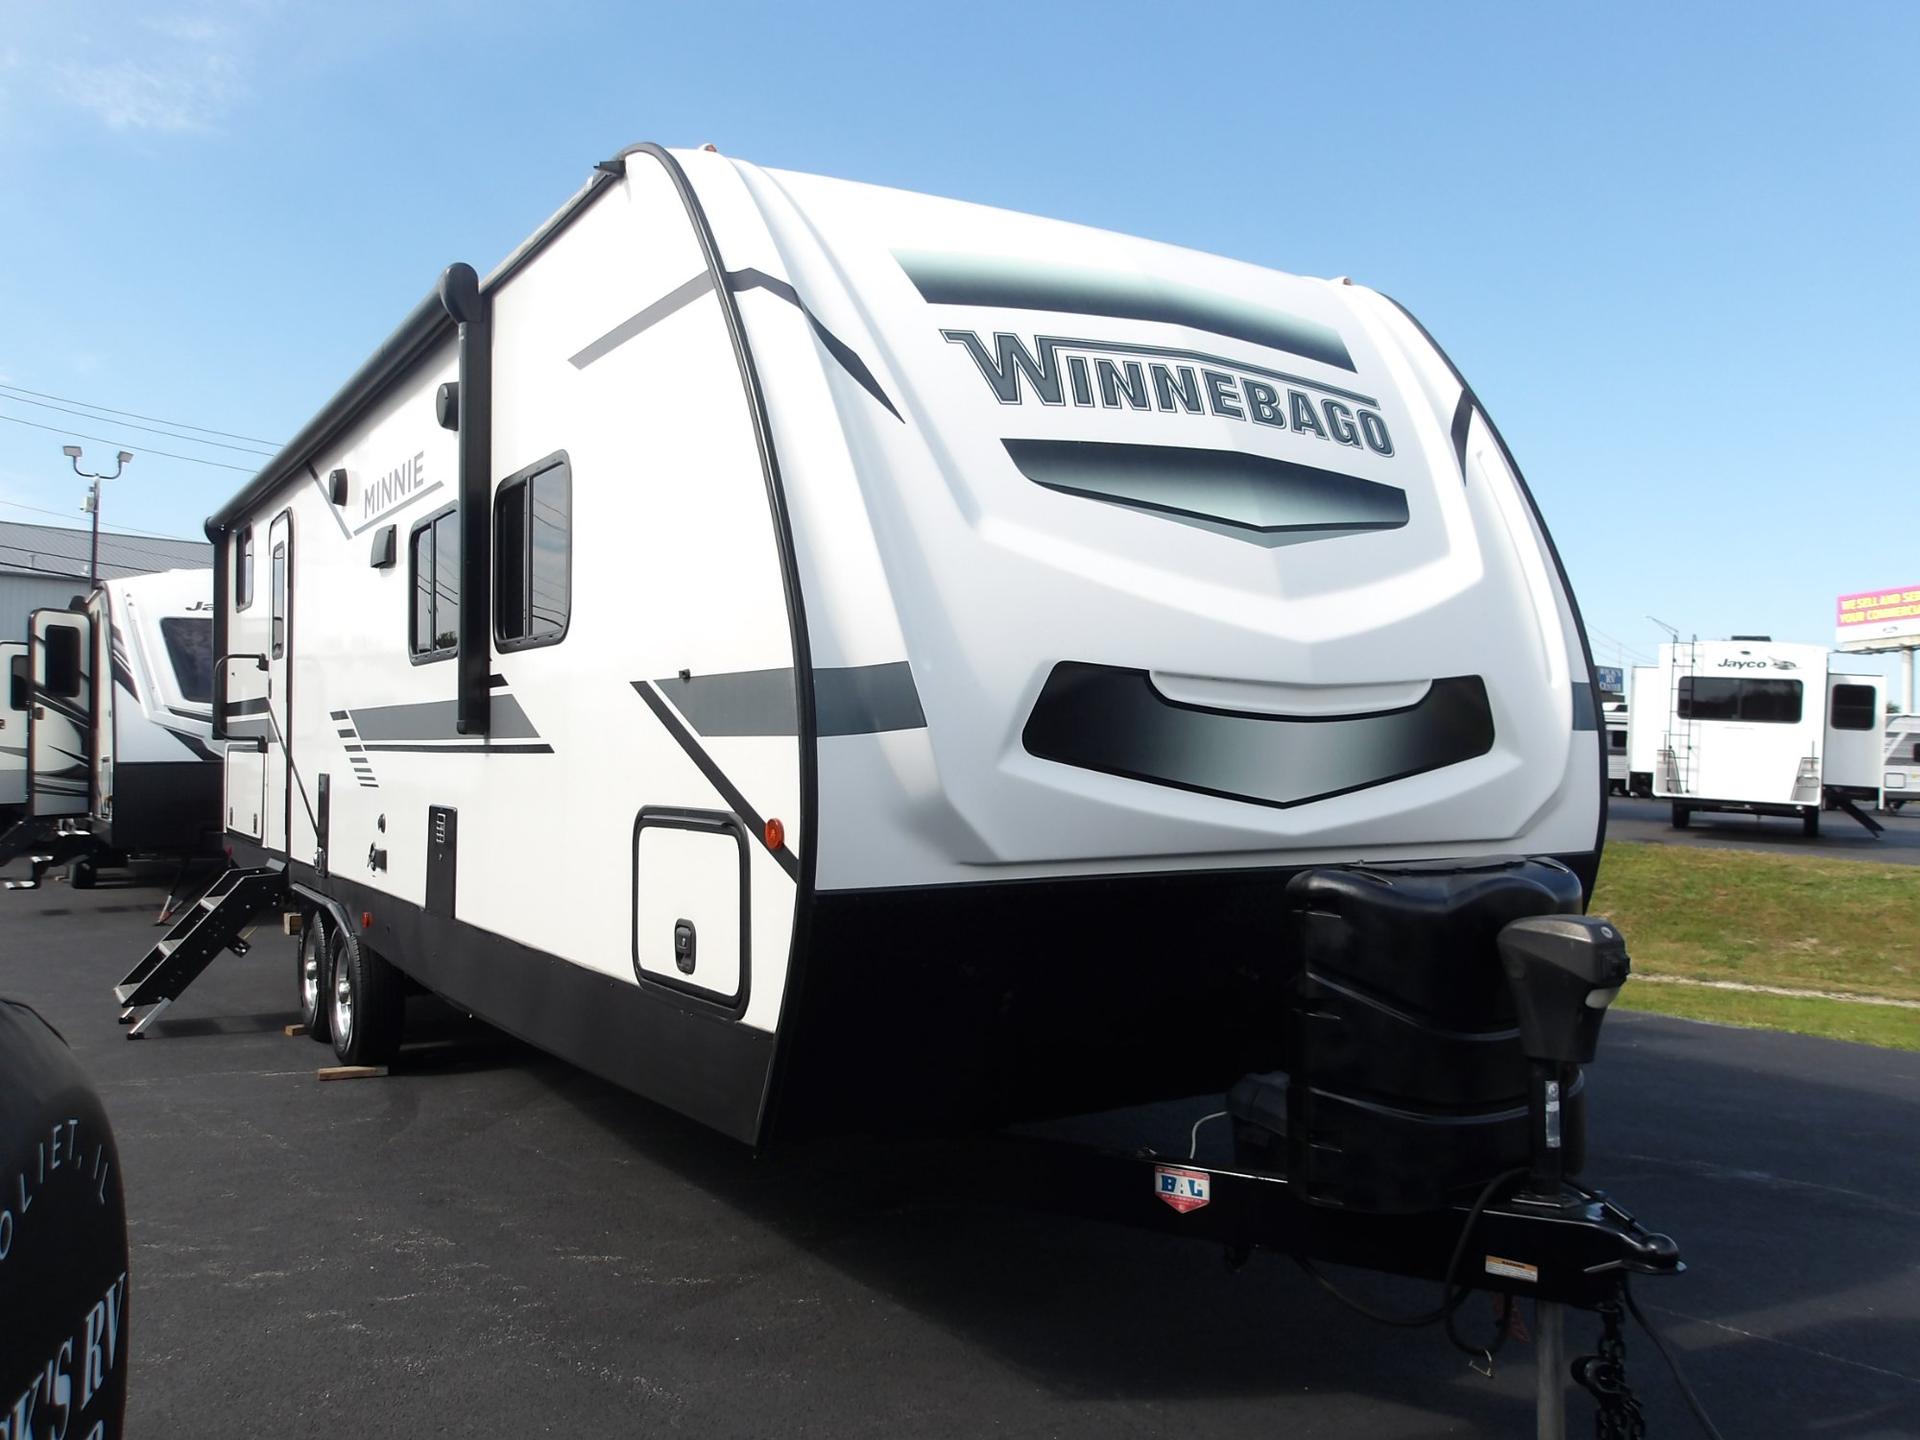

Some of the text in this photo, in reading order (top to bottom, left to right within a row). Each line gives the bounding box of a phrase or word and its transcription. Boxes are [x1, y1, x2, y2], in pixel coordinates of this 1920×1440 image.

[938, 328, 1396, 458] WINNEBAGO
[364, 451, 425, 520] MINNIE
[1717, 658, 1768, 671] Jayco
[0, 1118, 82, 1261] OLIET,
[0, 1271, 127, 1440] K'S RV
